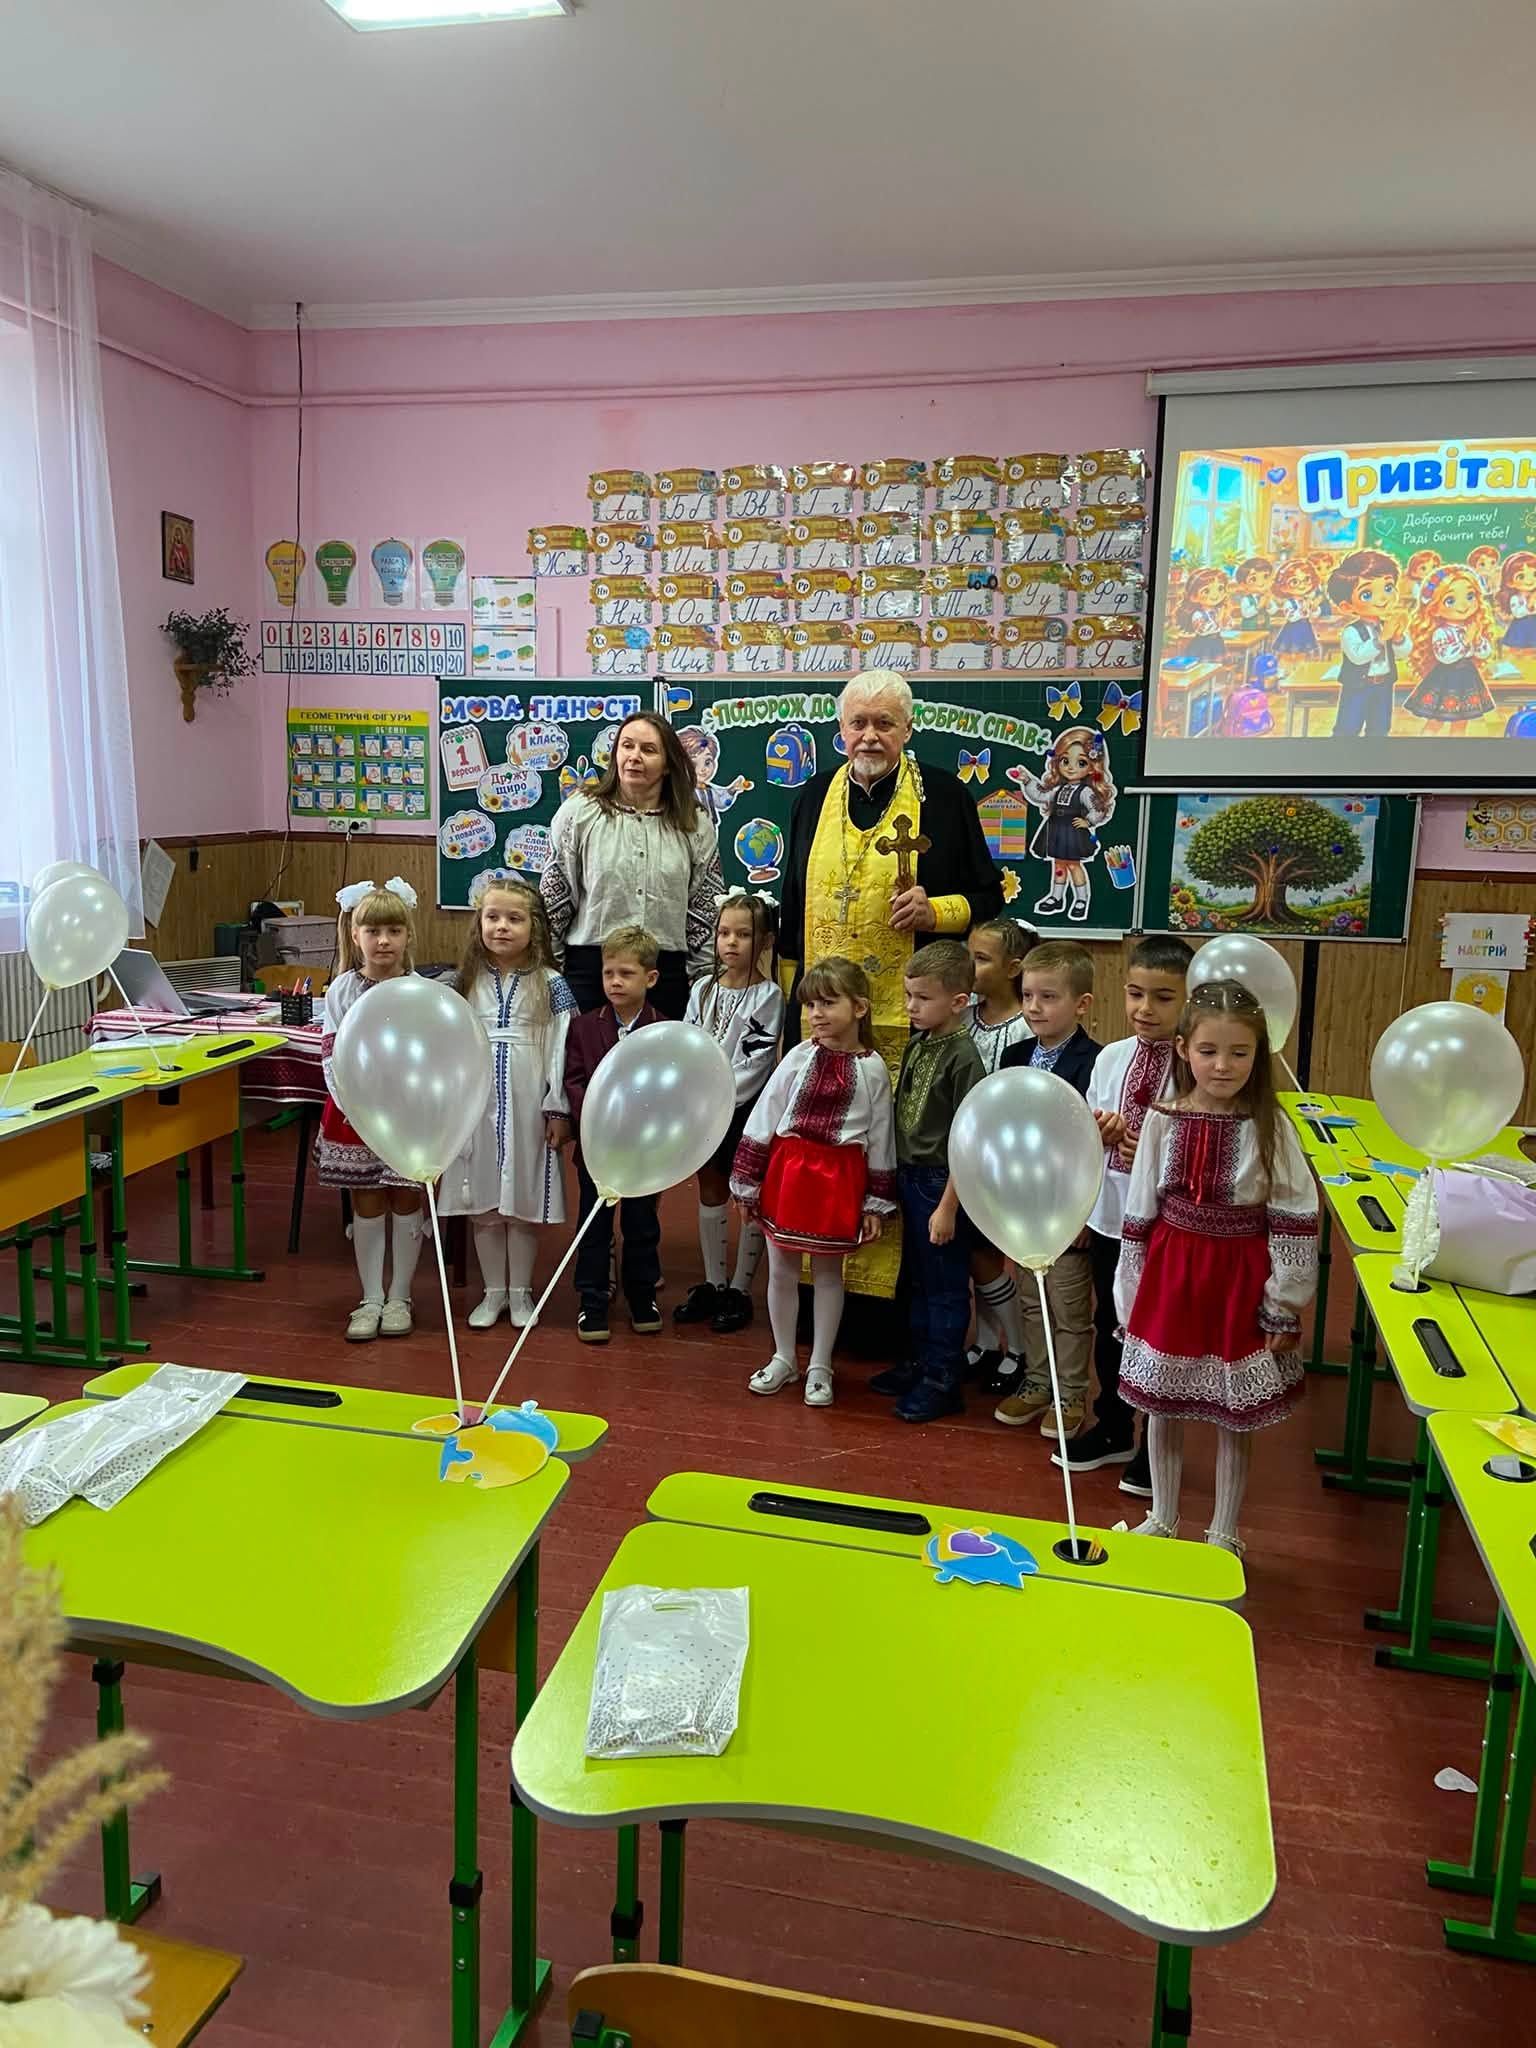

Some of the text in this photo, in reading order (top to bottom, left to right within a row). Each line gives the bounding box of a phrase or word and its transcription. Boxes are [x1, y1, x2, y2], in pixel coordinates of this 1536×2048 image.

[1403, 508, 1498, 528] Доброго ранку!
[1402, 526, 1510, 545] Раді бачити тебе!
[266, 625, 462, 648] 0 1 2 3 4 5 6 7 8 9 10
[285, 653, 463, 673] 11 12 13 14 15 16 17 18 19 20
[300, 711, 369, 721] ГЕОМЕТРИЧНІ
[810, 695, 836, 720] ДО
[518, 731, 527, 749] 1
[983, 715, 1037, 748] СПРАВ
[456, 746, 469, 766] 1
[451, 765, 481, 778] вересня
[496, 781, 527, 795] щиро
[455, 826, 486, 841] повагою
[1472, 926, 1493, 940] МІЙ
[1458, 942, 1507, 957] НАСТРІЙ
